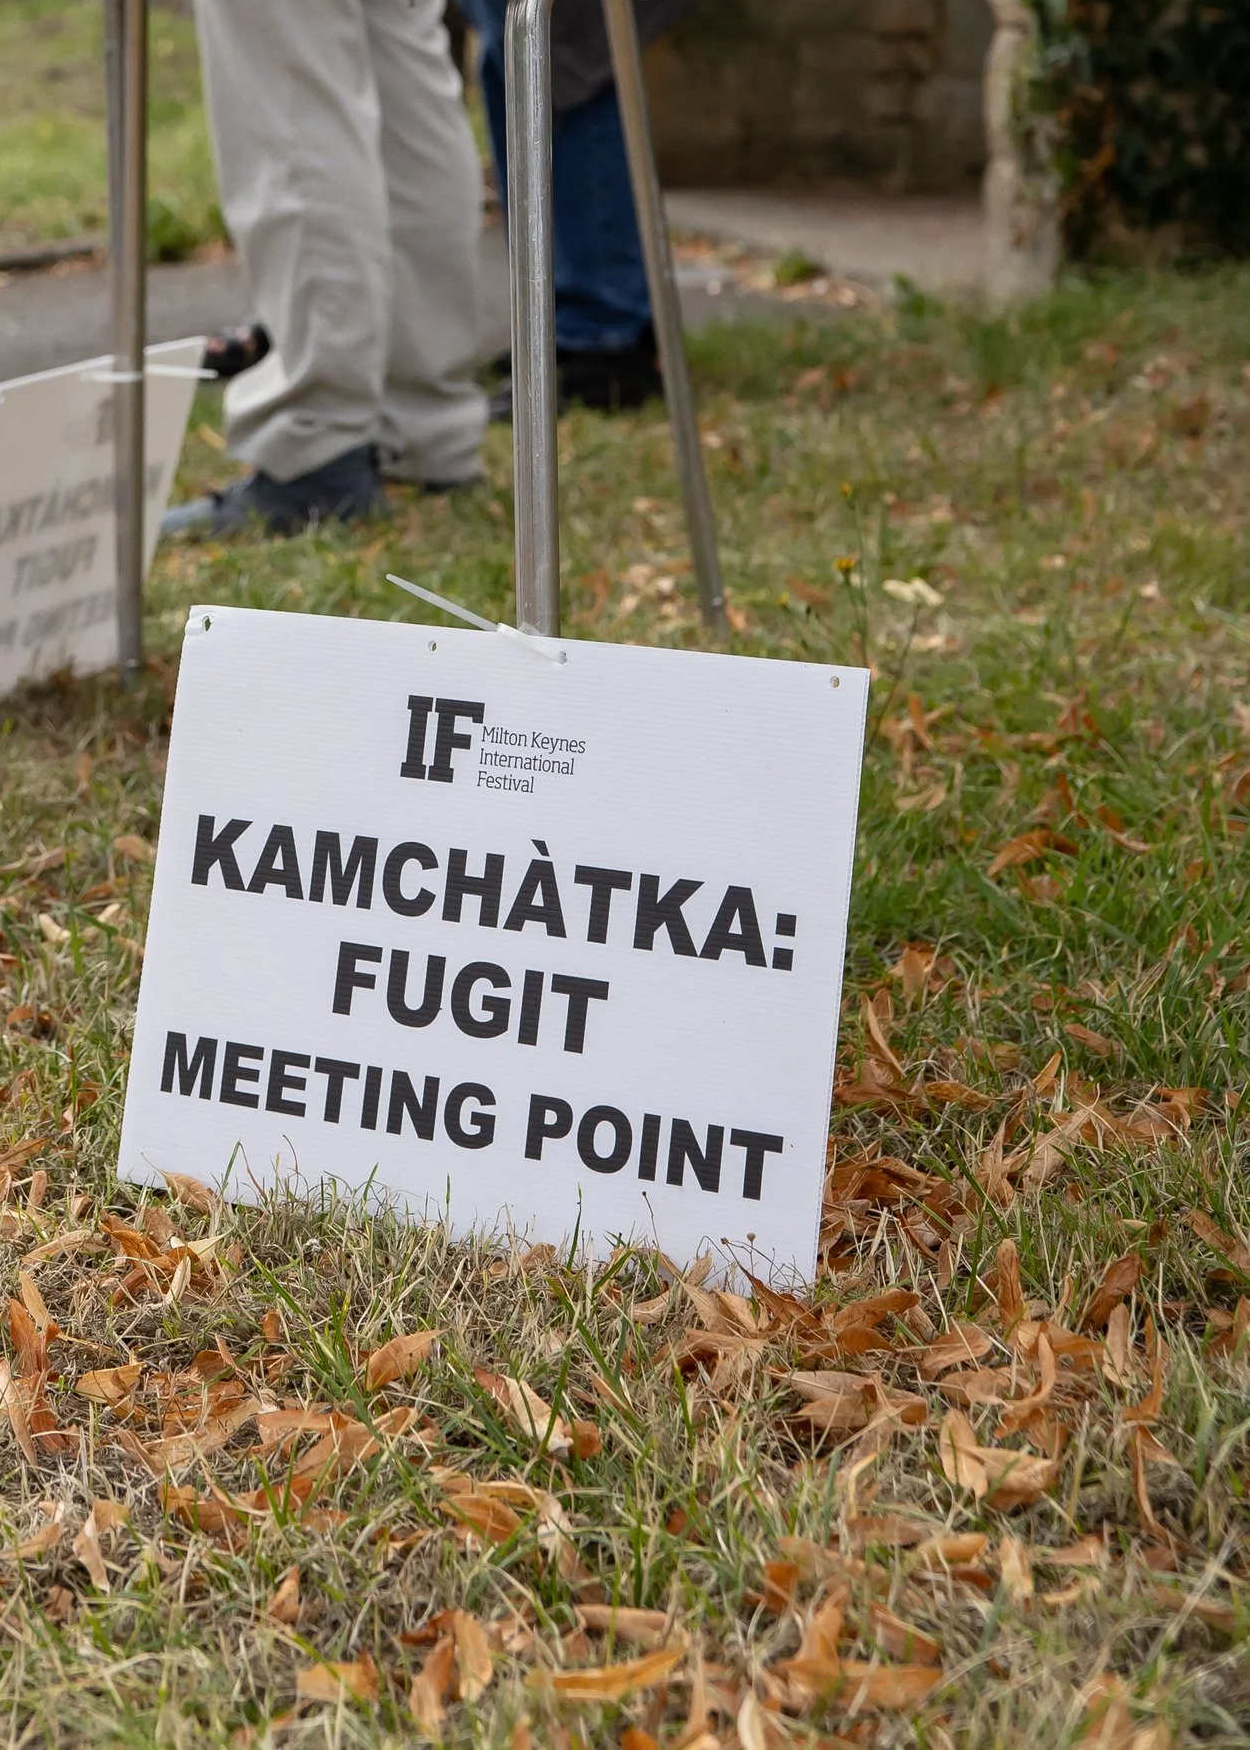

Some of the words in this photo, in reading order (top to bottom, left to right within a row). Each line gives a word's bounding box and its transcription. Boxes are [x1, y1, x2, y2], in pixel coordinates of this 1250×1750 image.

[400, 694, 485, 783] IF
[476, 770, 535, 794] Festival
[479, 747, 575, 776] International
[481, 725, 528, 748] Milton
[530, 731, 586, 755] Keynes
[191, 815, 797, 971] KAMCHÀTKA:
[332, 941, 610, 1054] FUGIT
[160, 1031, 497, 1150] MEETING
[524, 1094, 785, 1201] POINT
